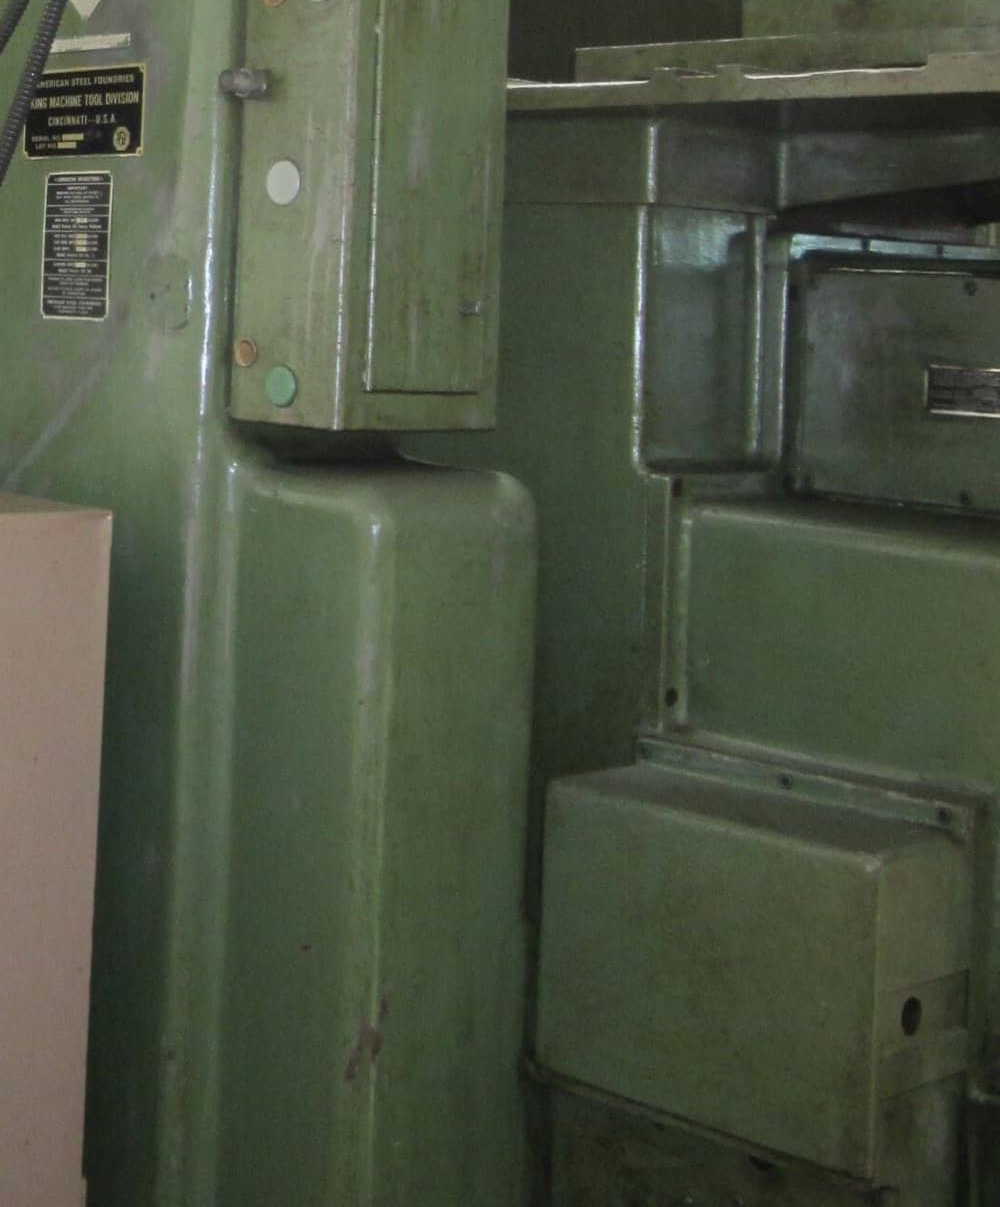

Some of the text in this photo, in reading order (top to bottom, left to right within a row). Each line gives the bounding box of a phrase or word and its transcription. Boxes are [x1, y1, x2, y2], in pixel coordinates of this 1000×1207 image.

[71, 77, 92, 87] STEEL
[94, 74, 134, 85] FOUNDRIES
[49, 95, 82, 109] MACHINE
[84, 93, 103, 106] TOOL
[105, 91, 140, 106] DIVISION
